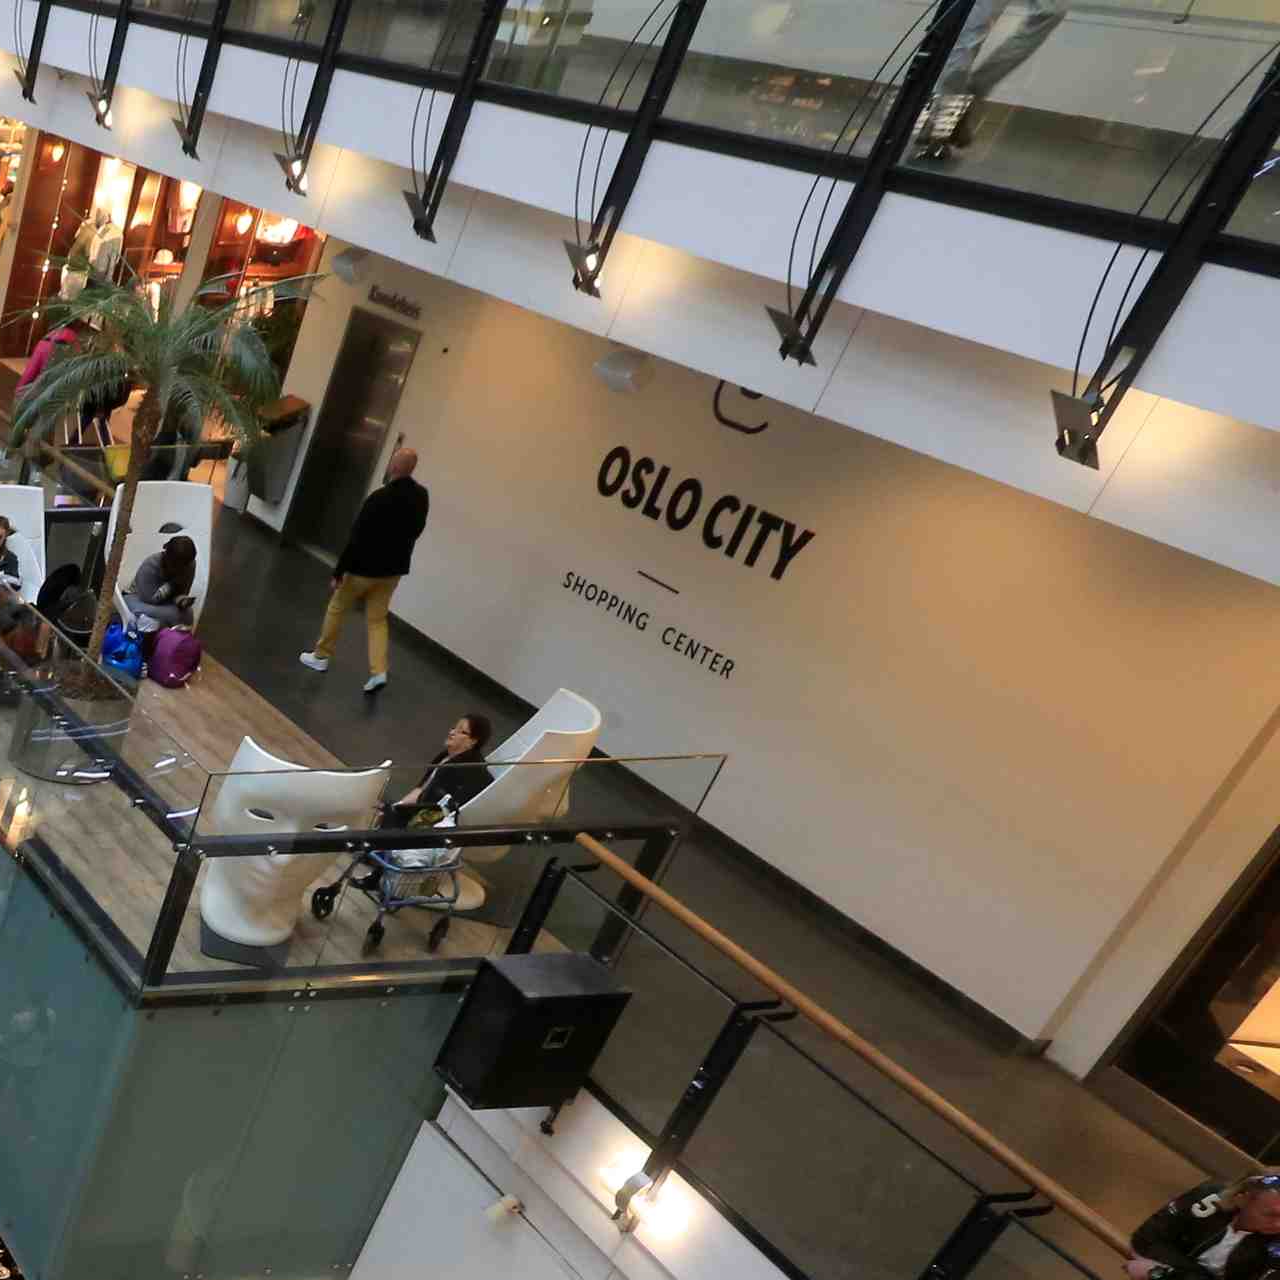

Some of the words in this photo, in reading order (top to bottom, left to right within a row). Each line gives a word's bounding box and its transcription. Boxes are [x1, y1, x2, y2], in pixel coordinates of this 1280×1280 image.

[597, 446, 703, 531] OSLO
[702, 494, 816, 581] CITY
[562, 571, 650, 631] SHOPPING
[661, 627, 736, 680] CENTER
[1191, 1193, 1221, 1218] 5
